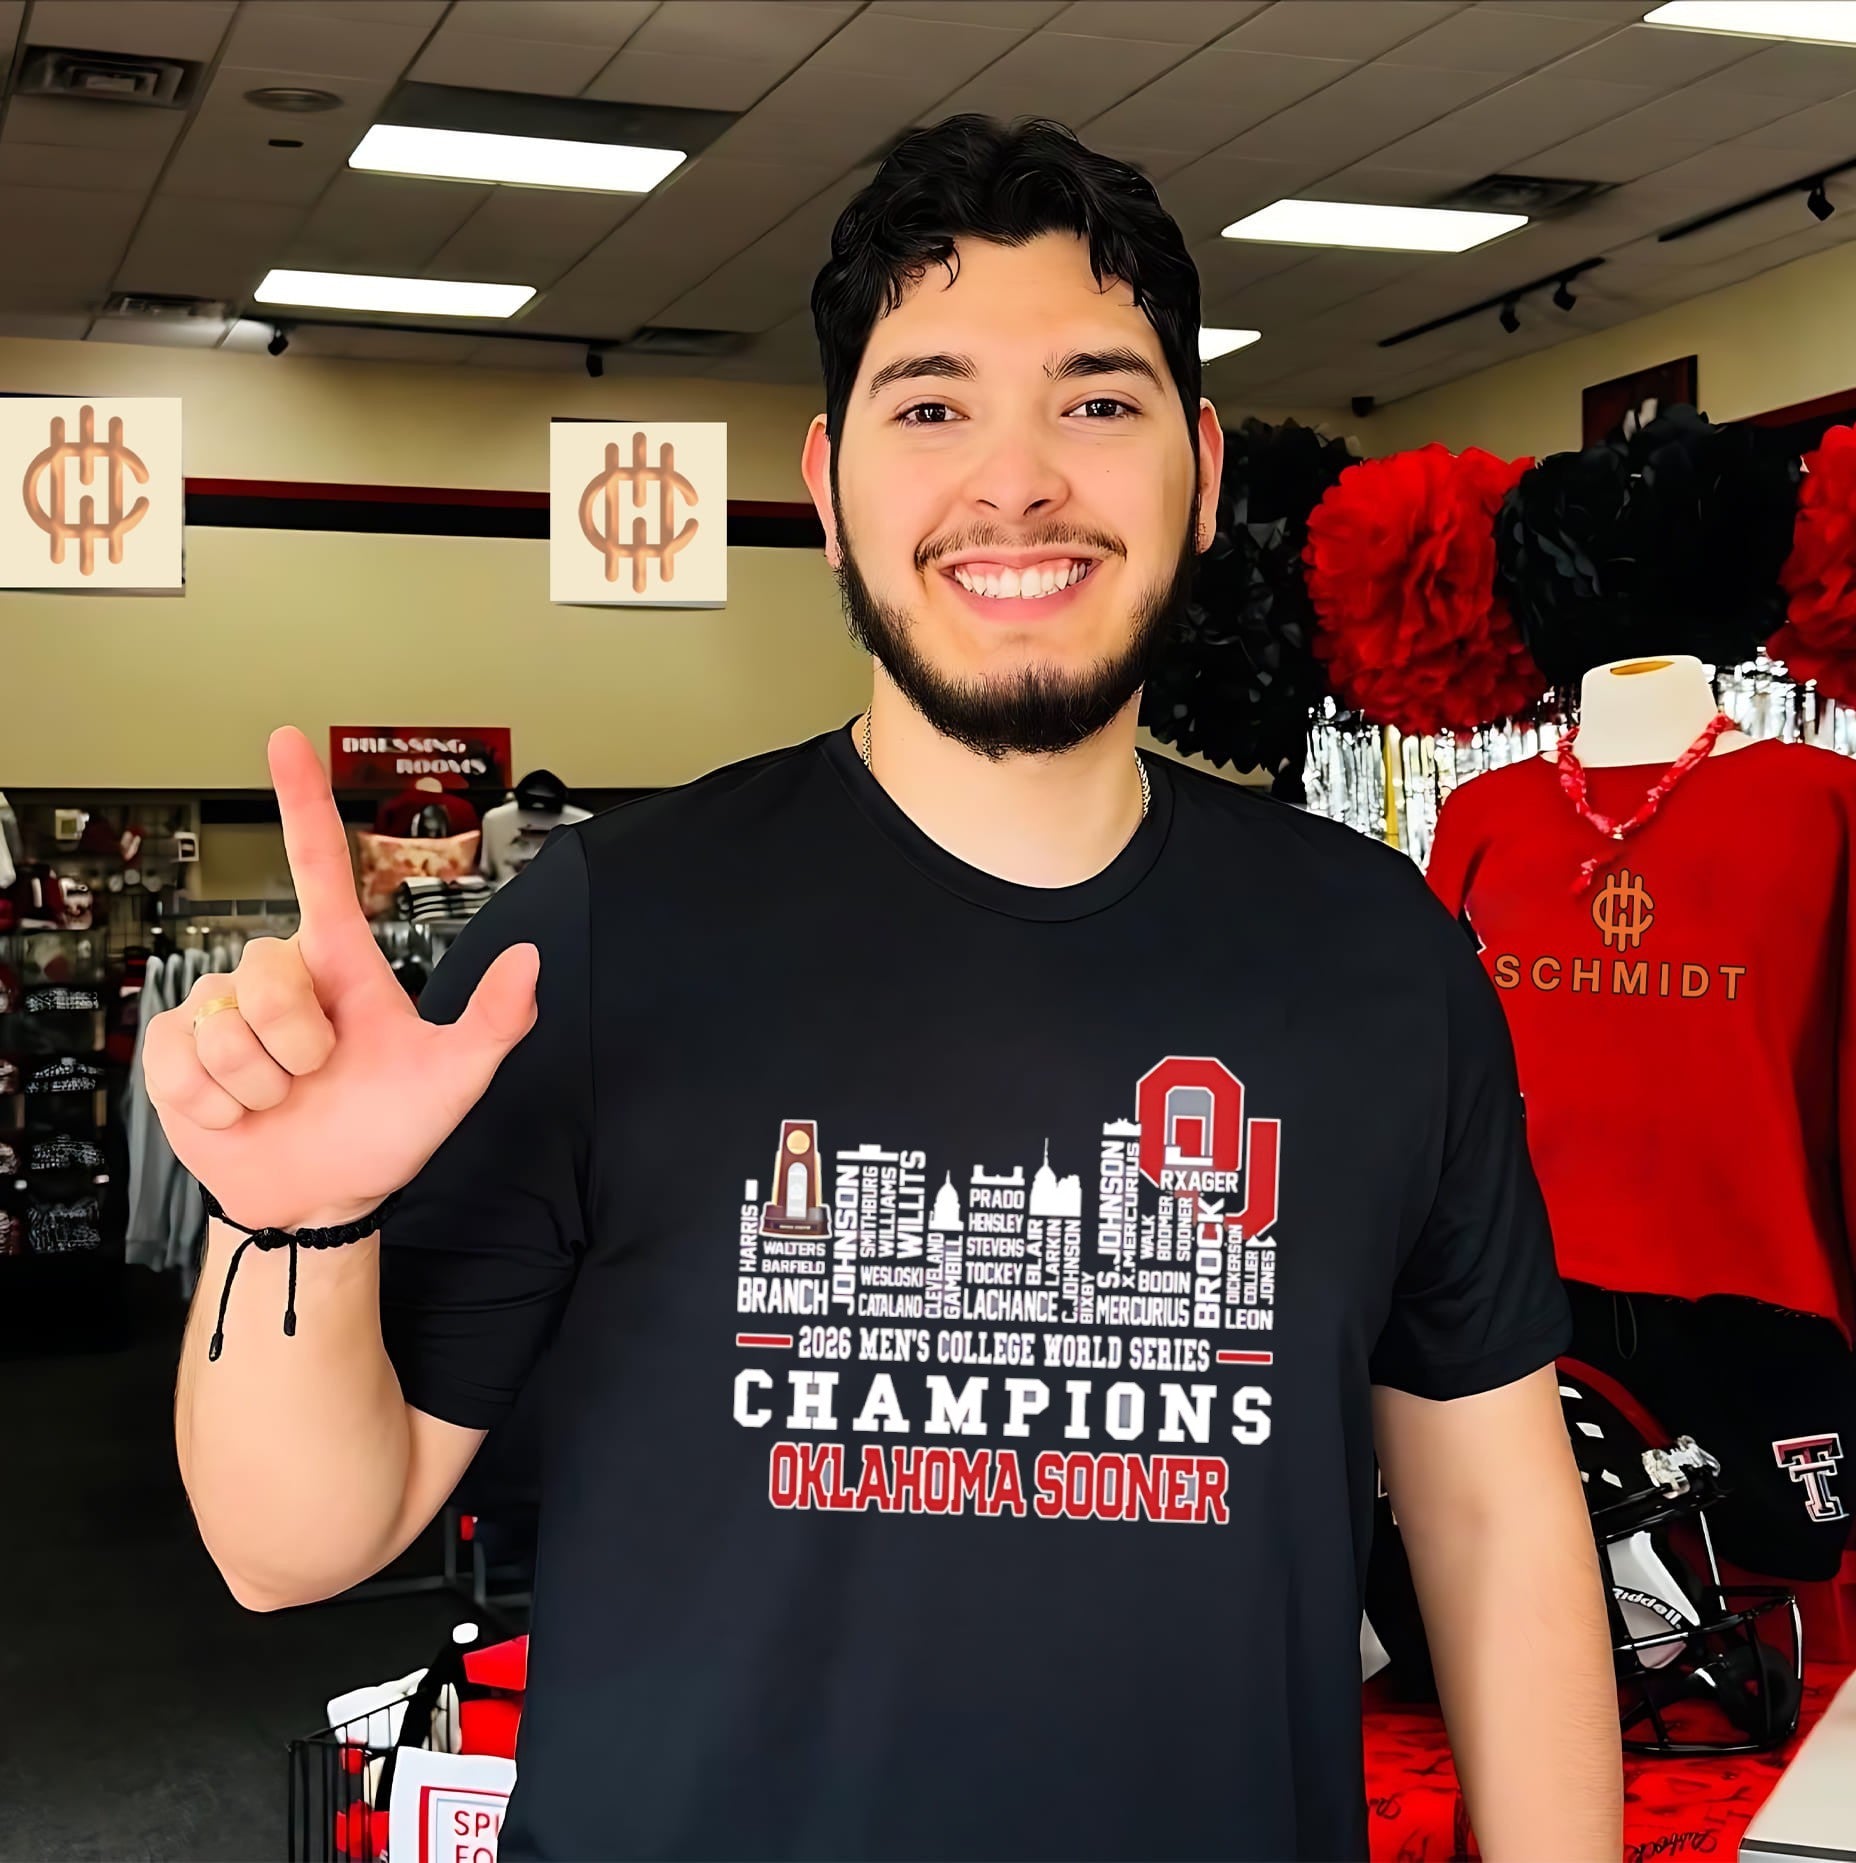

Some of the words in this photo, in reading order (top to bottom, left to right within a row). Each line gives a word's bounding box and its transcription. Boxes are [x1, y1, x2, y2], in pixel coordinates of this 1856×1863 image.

[396, 758, 487, 775] ROOMS
[1494, 954, 1746, 1000] SCHMIDT
[897, 1150, 926, 1259] WILLITS
[969, 1188, 1026, 1209] PRADO
[1160, 1169, 1239, 1193] RXAGER
[739, 1204, 759, 1273] HARRIS
[860, 1165, 878, 1258] SMITHBURG
[879, 1167, 897, 1258] WILLIAMS
[968, 1212, 1024, 1233] HENSLEY
[1096, 1140, 1125, 1289] S.JOHNSON
[1122, 1142, 1140, 1288] X.MERCURIUS
[1140, 1214, 1156, 1260] WALK
[1156, 1195, 1174, 1261] BOOMER
[1176, 1197, 1194, 1262] SOONER
[761, 1259, 826, 1275] BARFIELD
[762, 1240, 826, 1257] WALTERS
[832, 1165, 860, 1316] JOHNSON
[966, 1236, 1026, 1258] STEVENS
[1025, 1219, 1044, 1286] BLAIR
[1045, 1218, 1062, 1287] LARKIN
[1194, 1197, 1225, 1329] BROCK
[1225, 1224, 1243, 1305] DICKERSON
[737, 1276, 829, 1316] BRANCH
[860, 1265, 924, 1288] WESLOSKI
[924, 1232, 945, 1319] CLEVELAND
[944, 1235, 963, 1319] GAMBILL
[965, 1260, 1024, 1286] TOCKEY
[1061, 1219, 1082, 1324] C.JOHNSON
[1079, 1271, 1096, 1325] BIXBY
[1138, 1270, 1191, 1294] BODIN
[1243, 1249, 1260, 1305] COLLIER
[1260, 1249, 1276, 1305] JONES
[858, 1293, 923, 1319] CATALANO
[963, 1287, 1059, 1323] LACHANCE
[1096, 1295, 1190, 1327] MERCURIUS
[1225, 1308, 1274, 1331] LEON
[798, 1325, 852, 1360] 2026
[858, 1327, 931, 1363] MEN'S
[937, 1329, 1036, 1367] COLLEGE
[1043, 1333, 1122, 1369] WORLD
[1129, 1336, 1211, 1373] SERIES
[732, 1367, 1274, 1446] CHAMPIONS
[768, 1441, 1028, 1518] OKLAHOMA
[1033, 1450, 1231, 1525] SOONER
